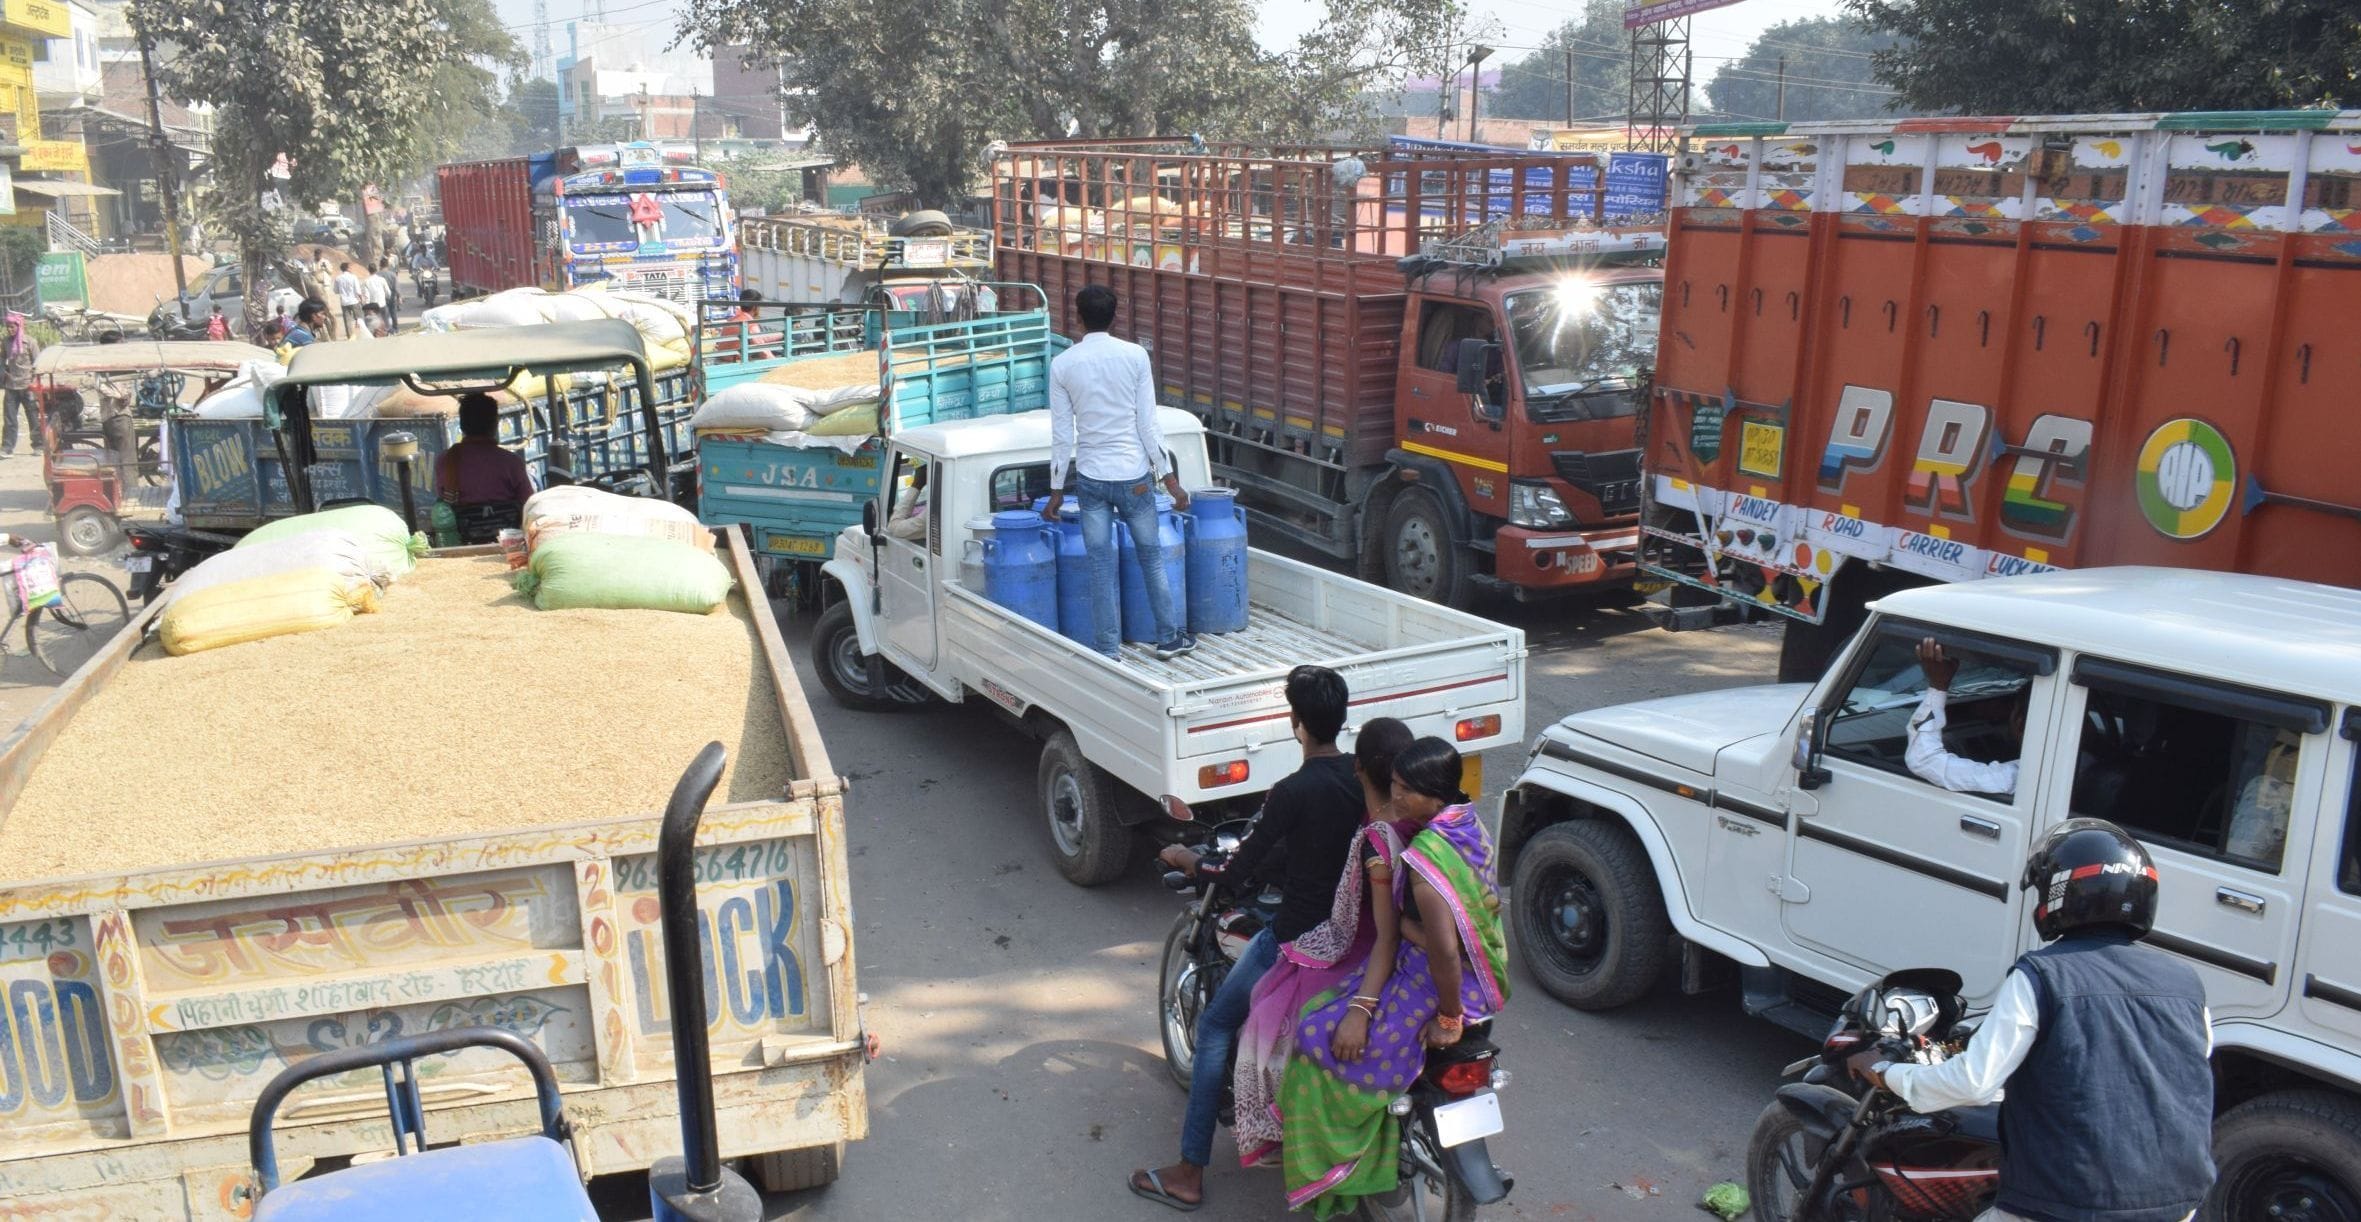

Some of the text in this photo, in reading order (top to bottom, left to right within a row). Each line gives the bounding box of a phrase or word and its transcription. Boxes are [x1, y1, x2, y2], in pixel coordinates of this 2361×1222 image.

[644, 272, 667, 280] TATA
[1435, 425, 1457, 436] EICHER
[192, 432, 249, 494] BLOW
[761, 463, 819, 489] JSA
[1732, 494, 1781, 523] PANDEY
[1822, 513, 1865, 538] ROAD
[1899, 530, 1964, 565] CARRIER
[1565, 553, 1598, 576] SPEED
[2101, 862, 2148, 878] NINJA
[96, 911, 163, 1121] MODEL
